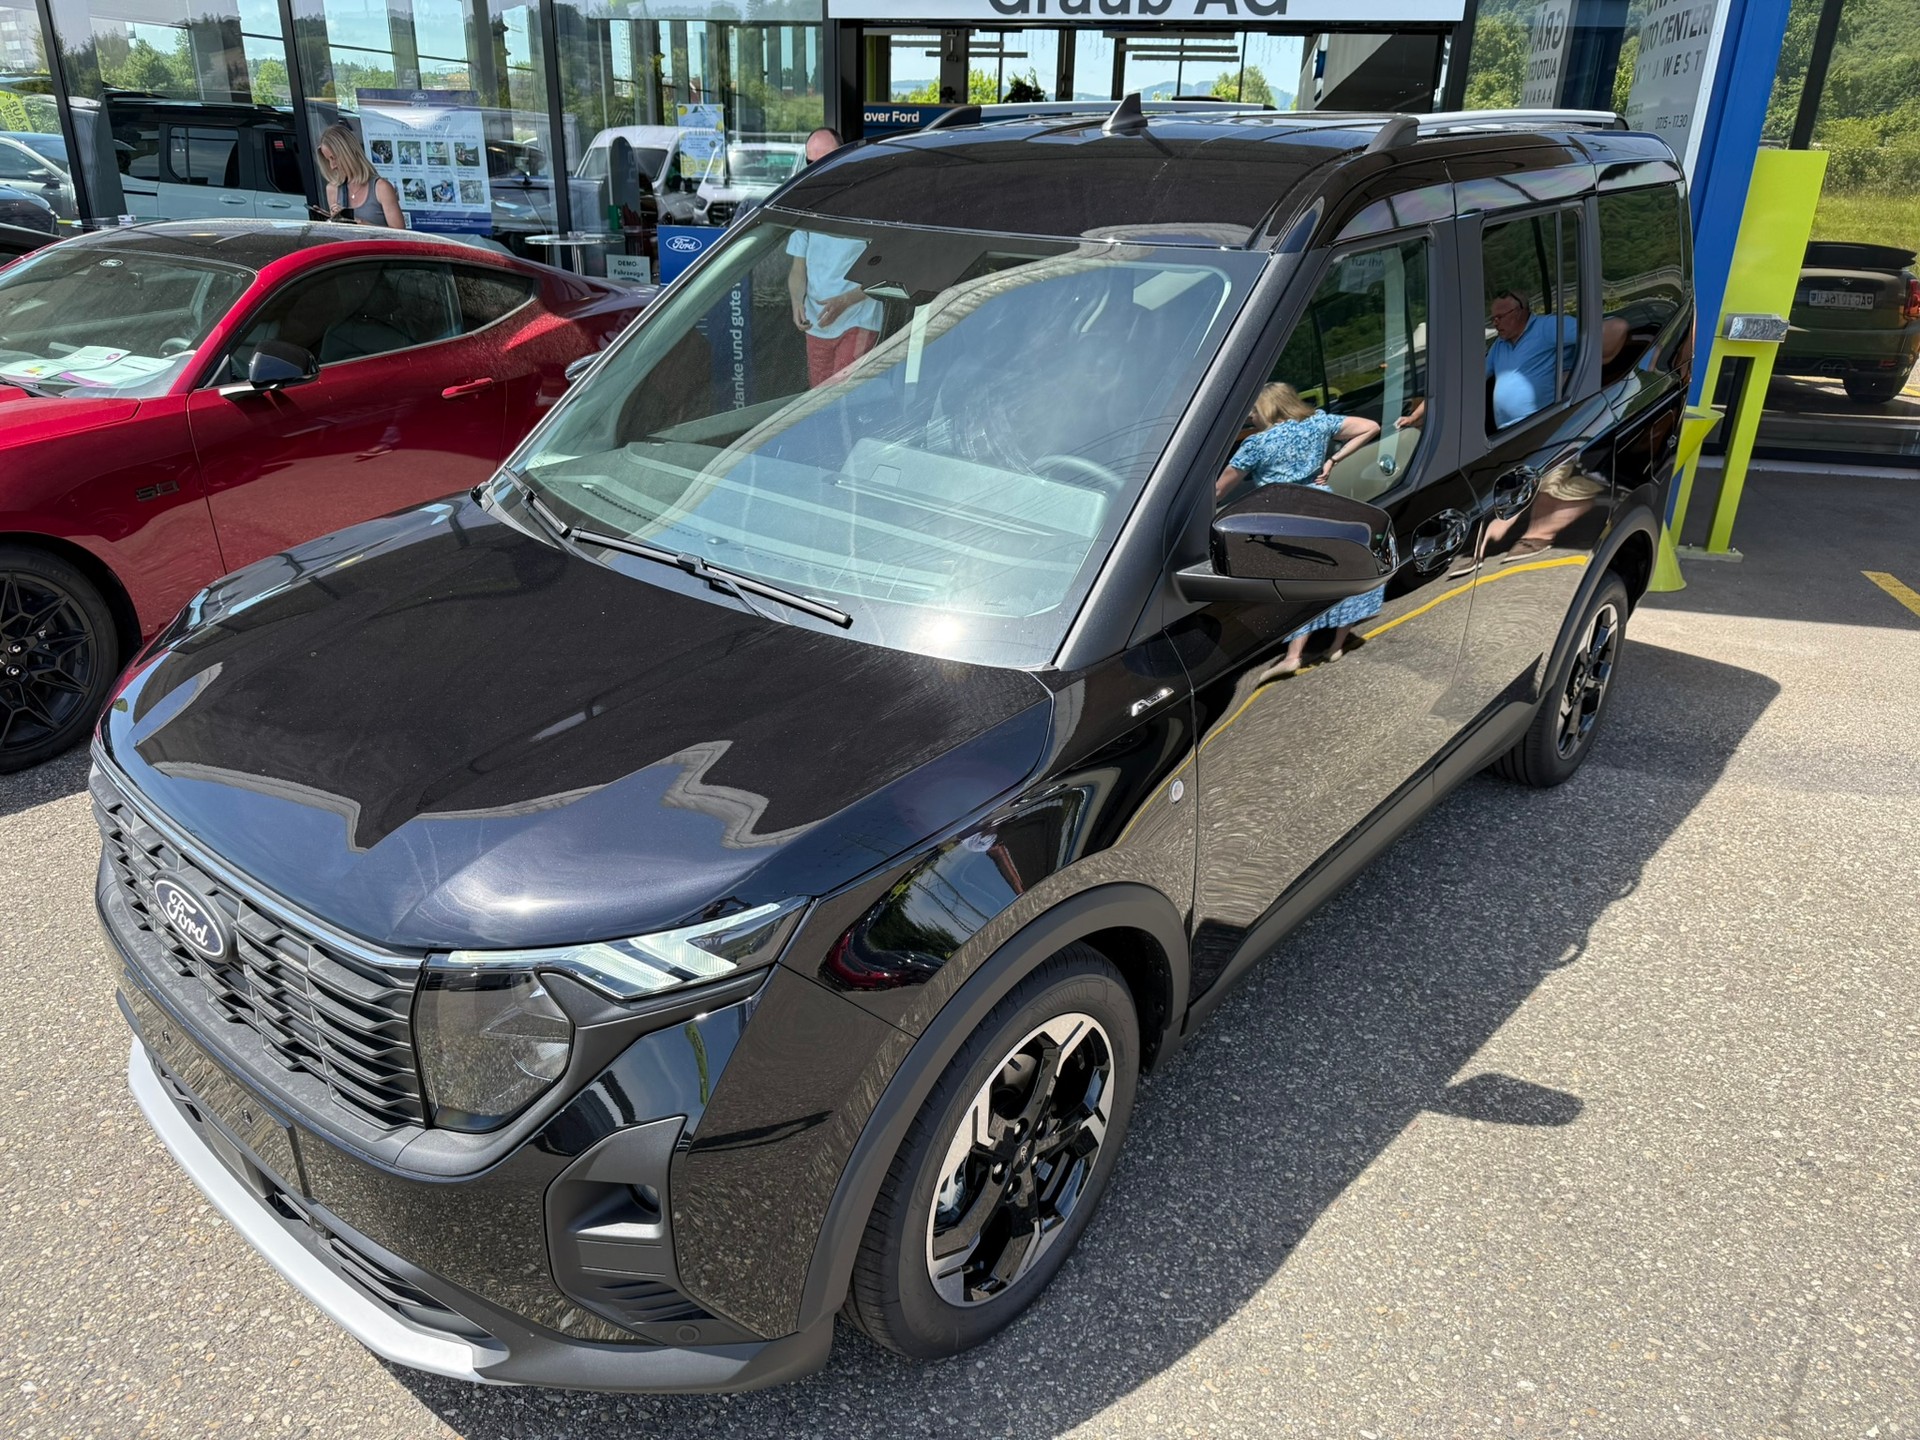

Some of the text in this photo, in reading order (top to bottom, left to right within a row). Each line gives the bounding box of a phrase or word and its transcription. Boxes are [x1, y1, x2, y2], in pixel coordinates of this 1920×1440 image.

[1659, 3, 1712, 48] CENTER
[1662, 50, 1703, 78] WEST
[892, 110, 920, 123] Ford
[671, 237, 696, 250] Ford
[613, 268, 644, 278] Fahrzeuge
[729, 290, 745, 327] gute
[729, 329, 743, 360] und
